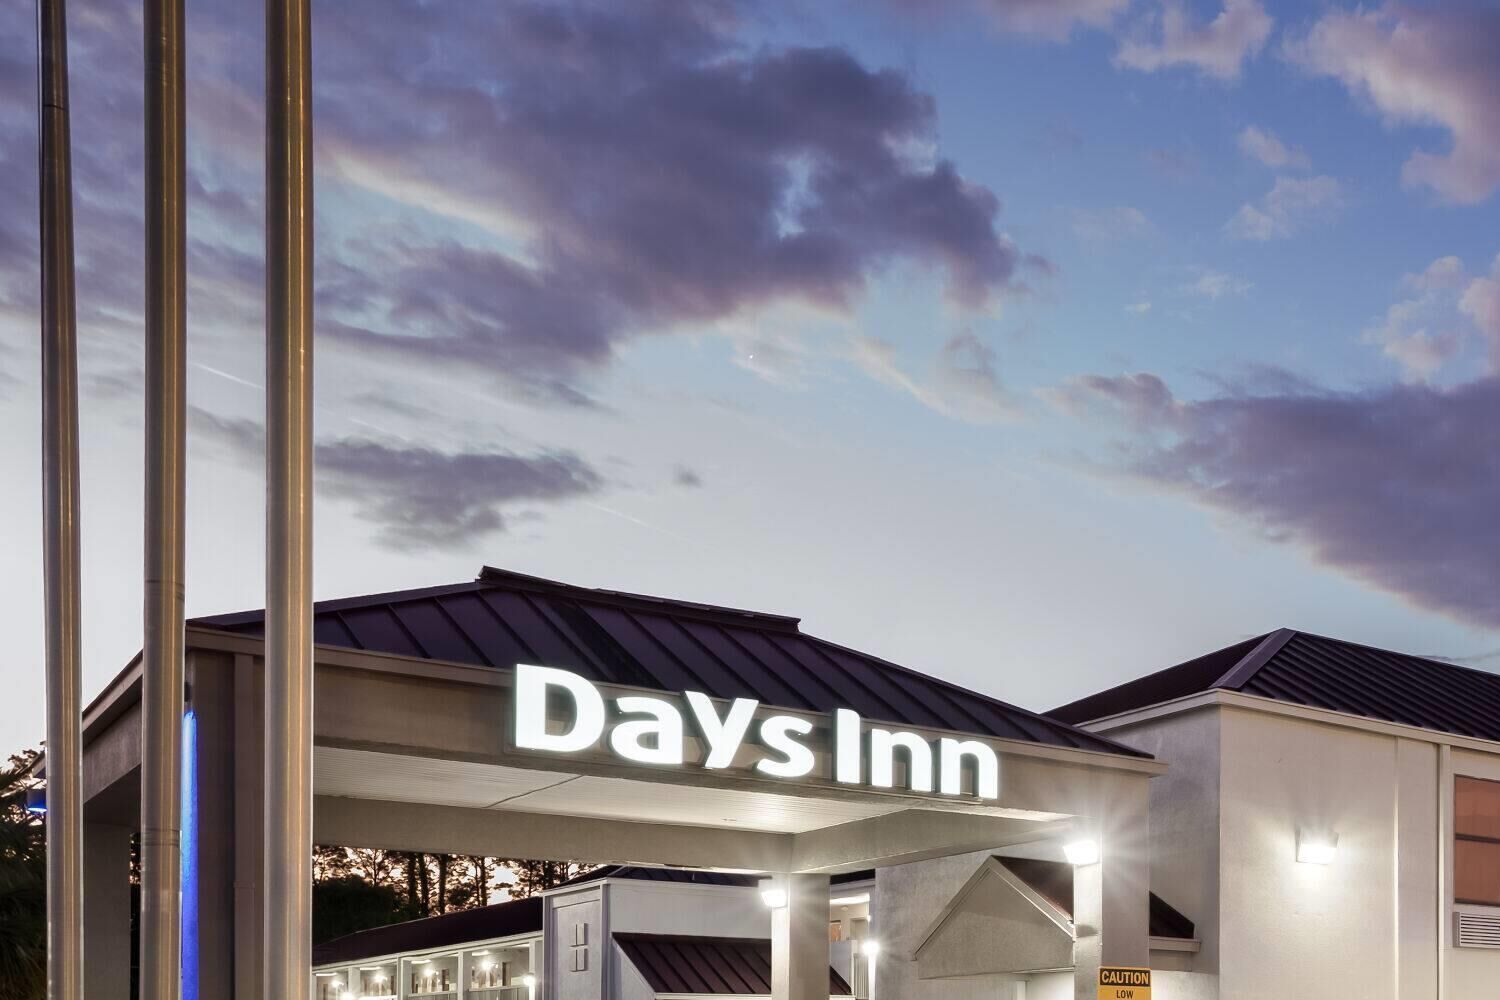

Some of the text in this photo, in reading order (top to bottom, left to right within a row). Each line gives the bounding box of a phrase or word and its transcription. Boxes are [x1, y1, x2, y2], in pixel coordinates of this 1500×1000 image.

[515, 663, 999, 800] Days Inn
[1101, 971, 1149, 985] CAUTION
[1116, 990, 1134, 999] LOW
